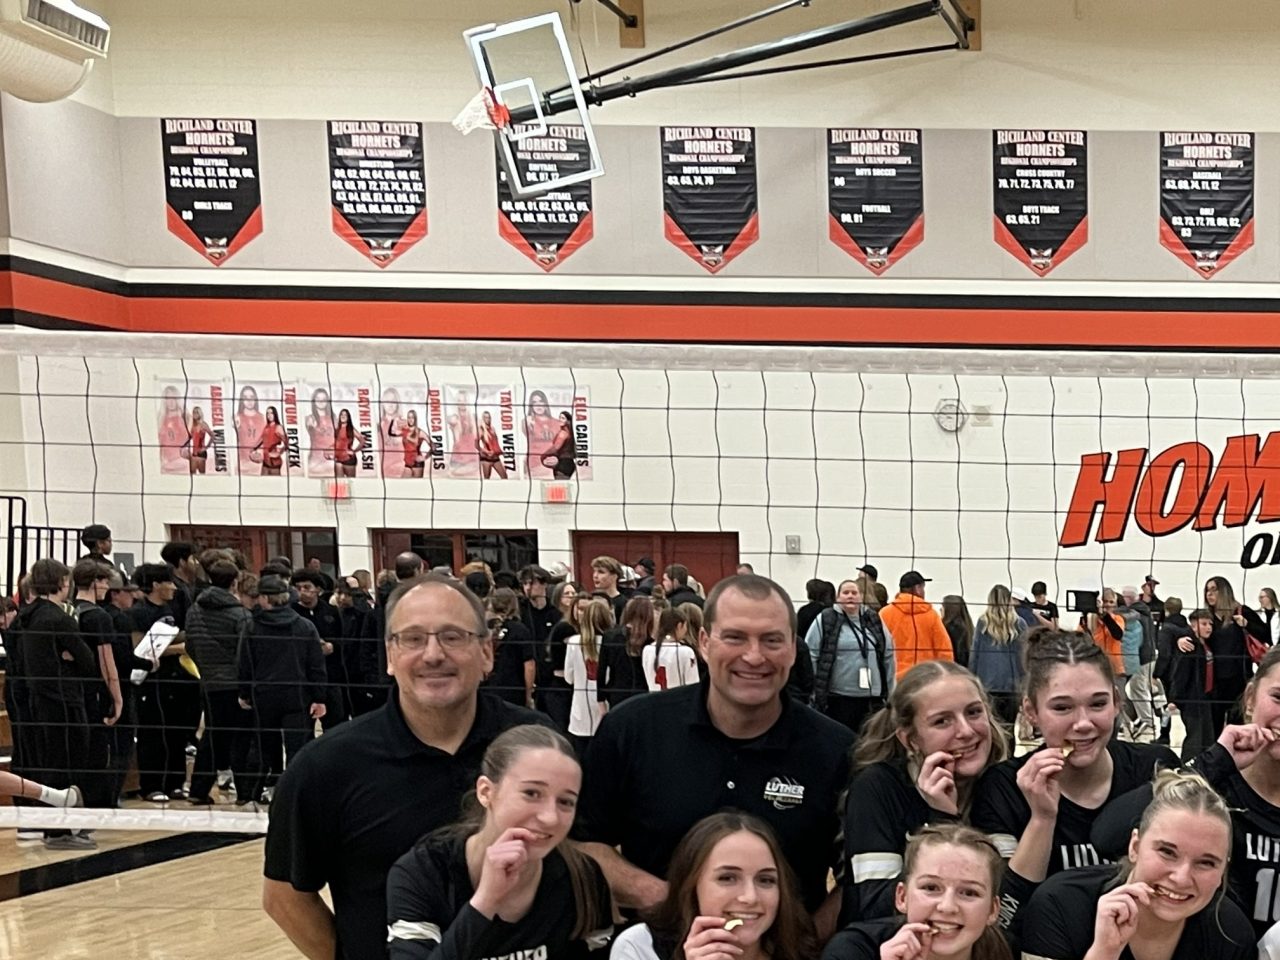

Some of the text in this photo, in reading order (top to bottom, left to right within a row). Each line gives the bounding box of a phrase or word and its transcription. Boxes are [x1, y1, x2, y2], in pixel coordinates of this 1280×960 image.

[165, 119, 253, 135] RICHLAND CENTER
[331, 122, 419, 137] RICHLAND CENTER
[549, 126, 585, 140] CENTER
[186, 133, 235, 146] HORNETS
[351, 135, 401, 148] HORNETS
[665, 128, 751, 142] RICHLAND CENTER
[831, 129, 918, 144] RICHLAND CENTER
[997, 131, 1084, 146] RICHLAND CENTER
[1164, 133, 1251, 148] RICHLAND CENTER
[518, 139, 567, 151] HORNETS
[684, 141, 733, 153] HORNETS
[851, 143, 900, 155] HORNETS
[1016, 144, 1065, 156] HORNETS
[1183, 146, 1232, 159] HORNETS
[284, 387, 297, 425] TATUM
[574, 396, 587, 422] ELLA
[500, 390, 516, 472] TAYLOR WERTZ
[360, 430, 374, 470] WALSH
[765, 782, 806, 795] LUTHER
